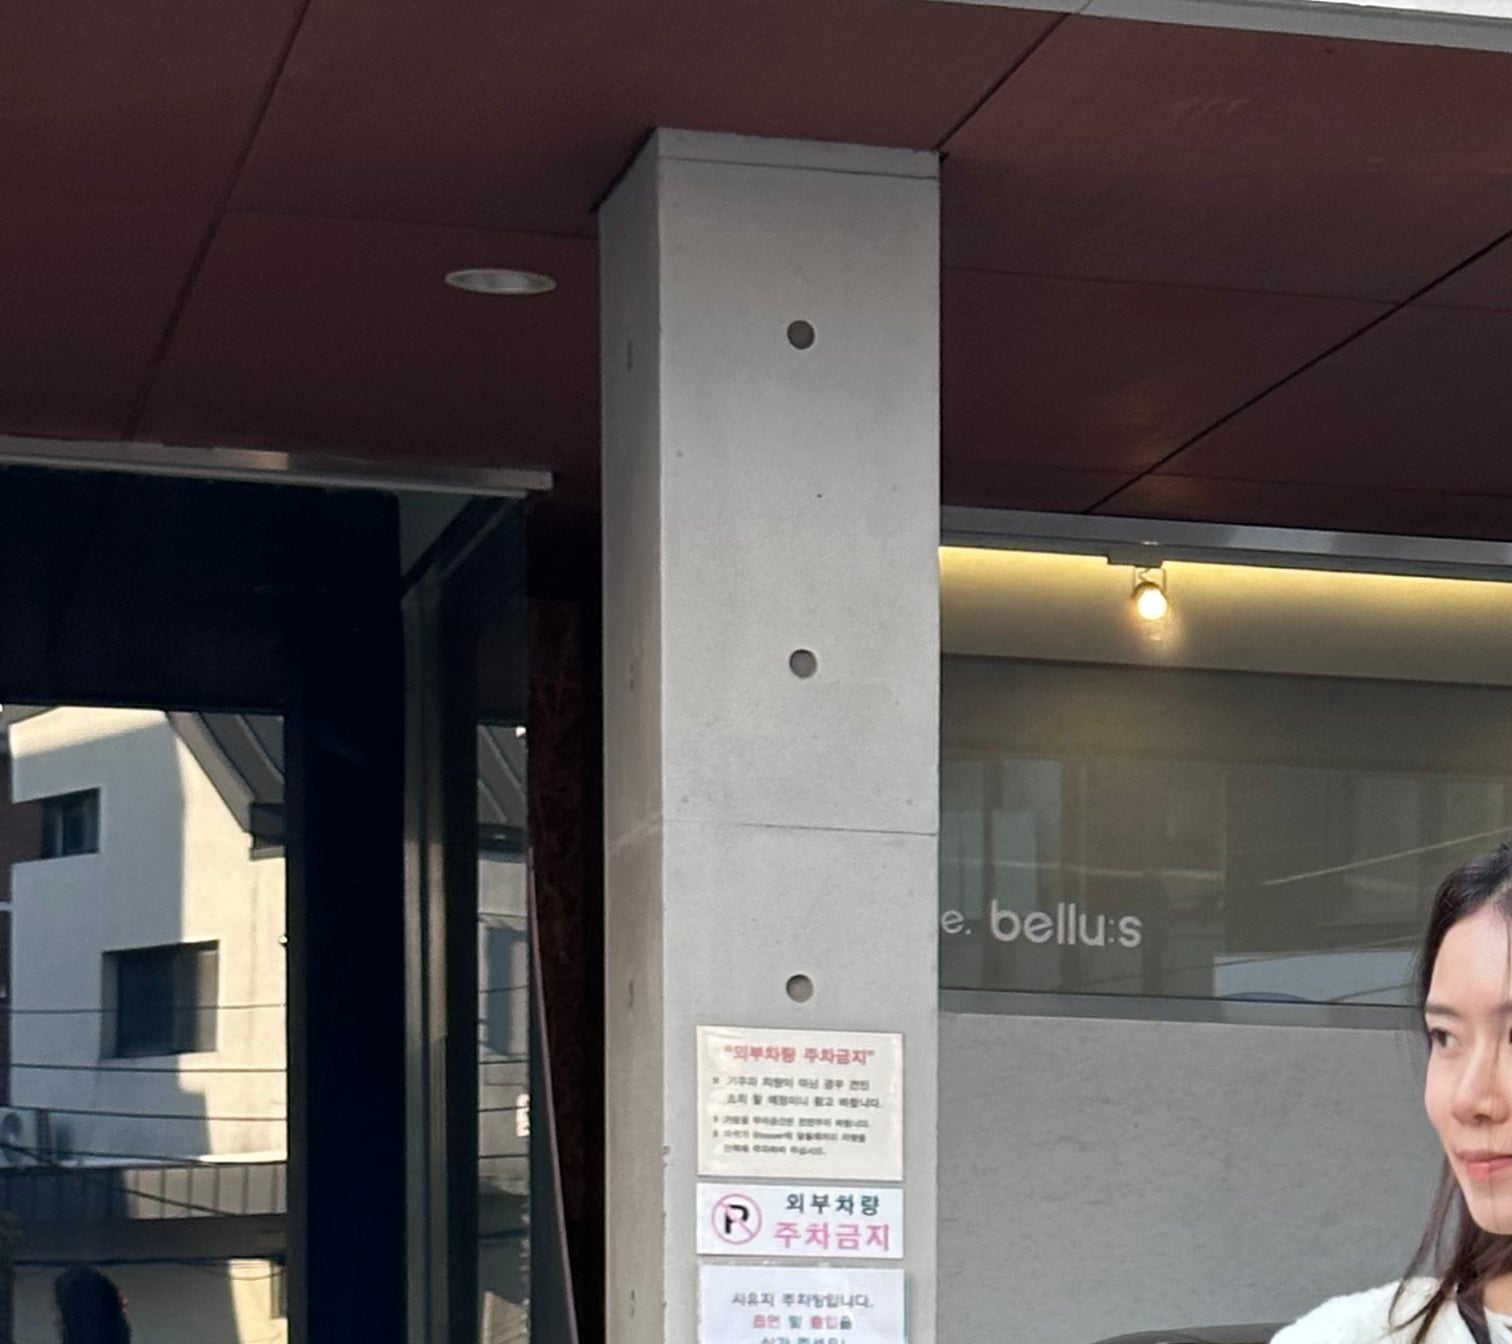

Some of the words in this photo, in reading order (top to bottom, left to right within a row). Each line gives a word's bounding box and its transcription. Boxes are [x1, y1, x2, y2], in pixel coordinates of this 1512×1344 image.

[990, 899, 1143, 948] bellu:s
[785, 1193, 880, 1216] 외부차량
[773, 1221, 890, 1252] 주차금지
